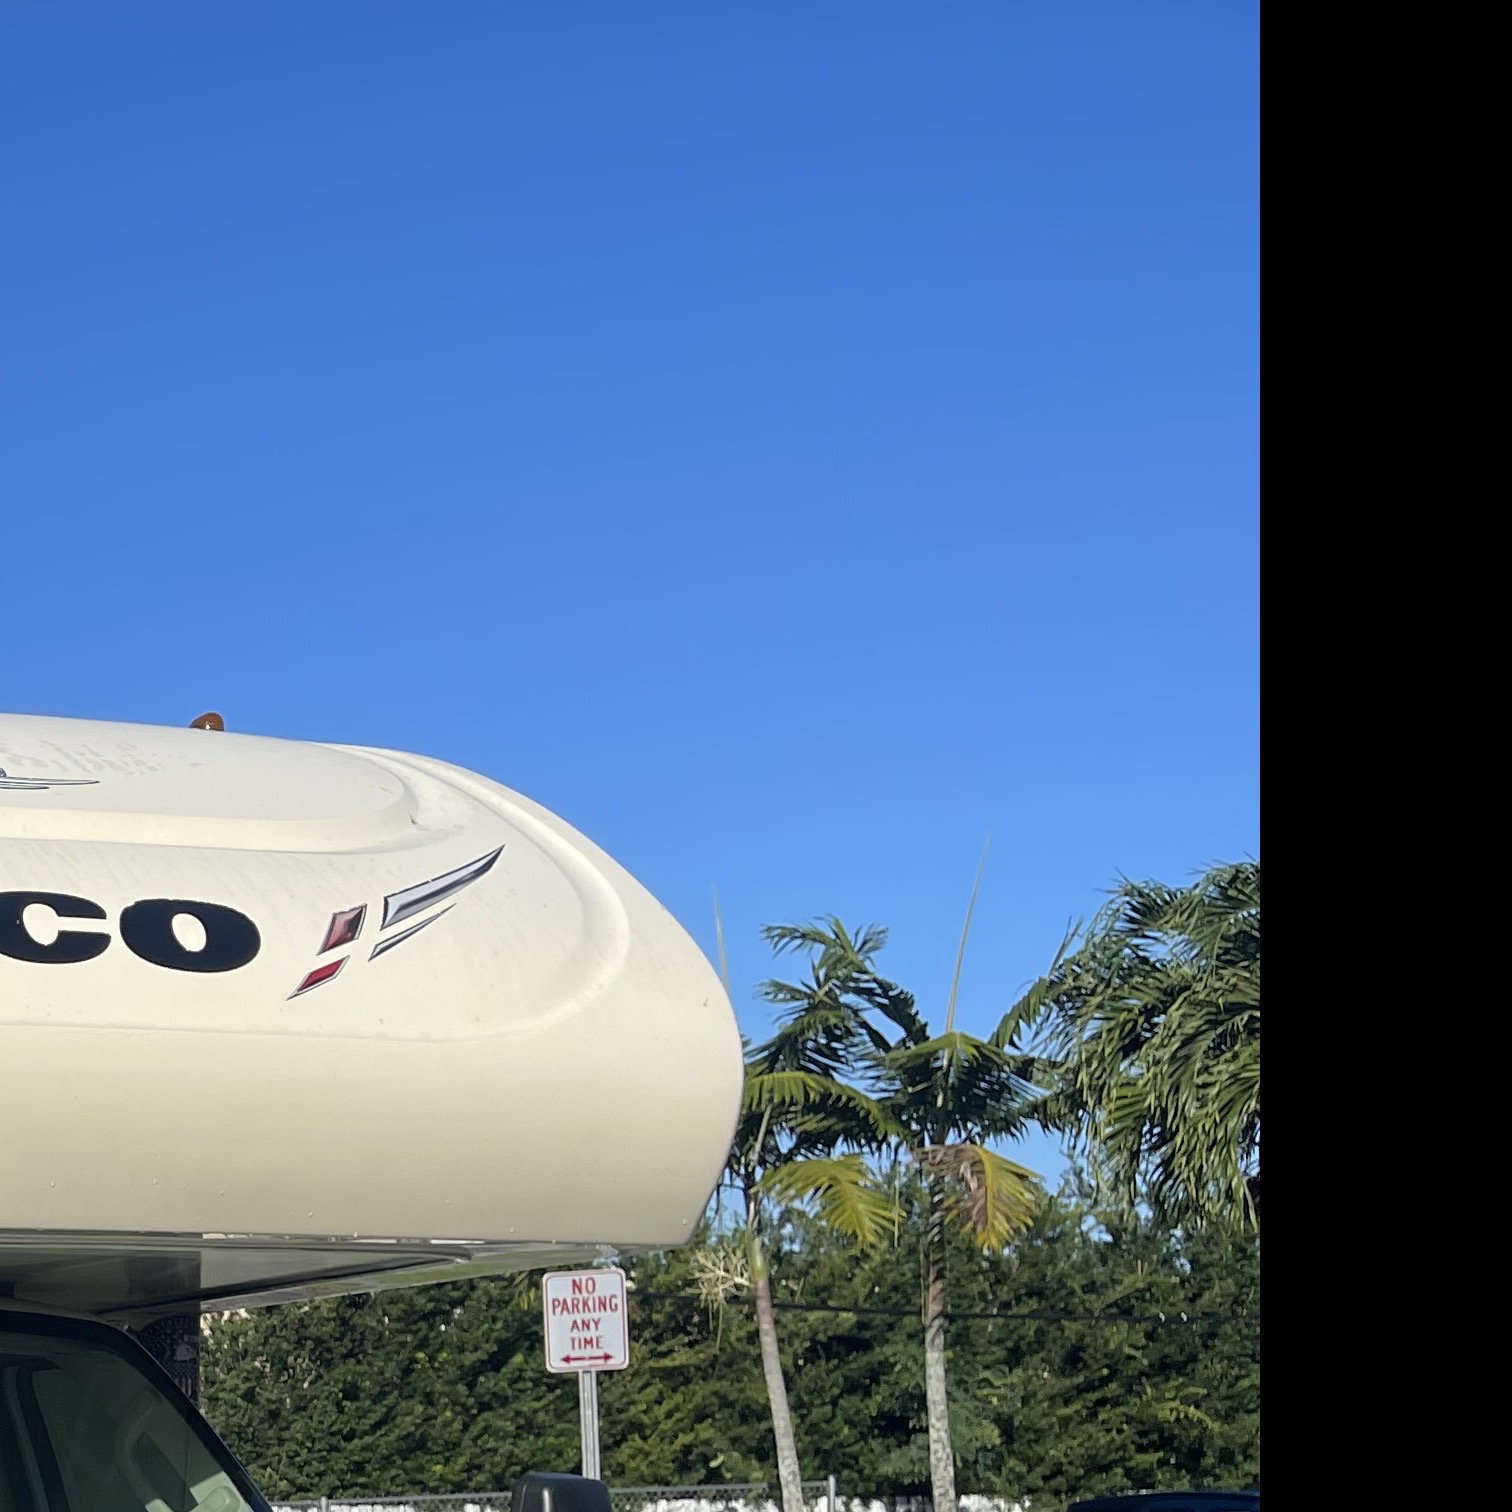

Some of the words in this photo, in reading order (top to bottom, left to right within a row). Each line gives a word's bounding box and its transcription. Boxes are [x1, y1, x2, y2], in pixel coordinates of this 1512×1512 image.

[571, 1276, 596, 1295] NO
[552, 1294, 619, 1316] PARKING
[570, 1317, 601, 1333] ANY
[569, 1335, 605, 1351] TIME
